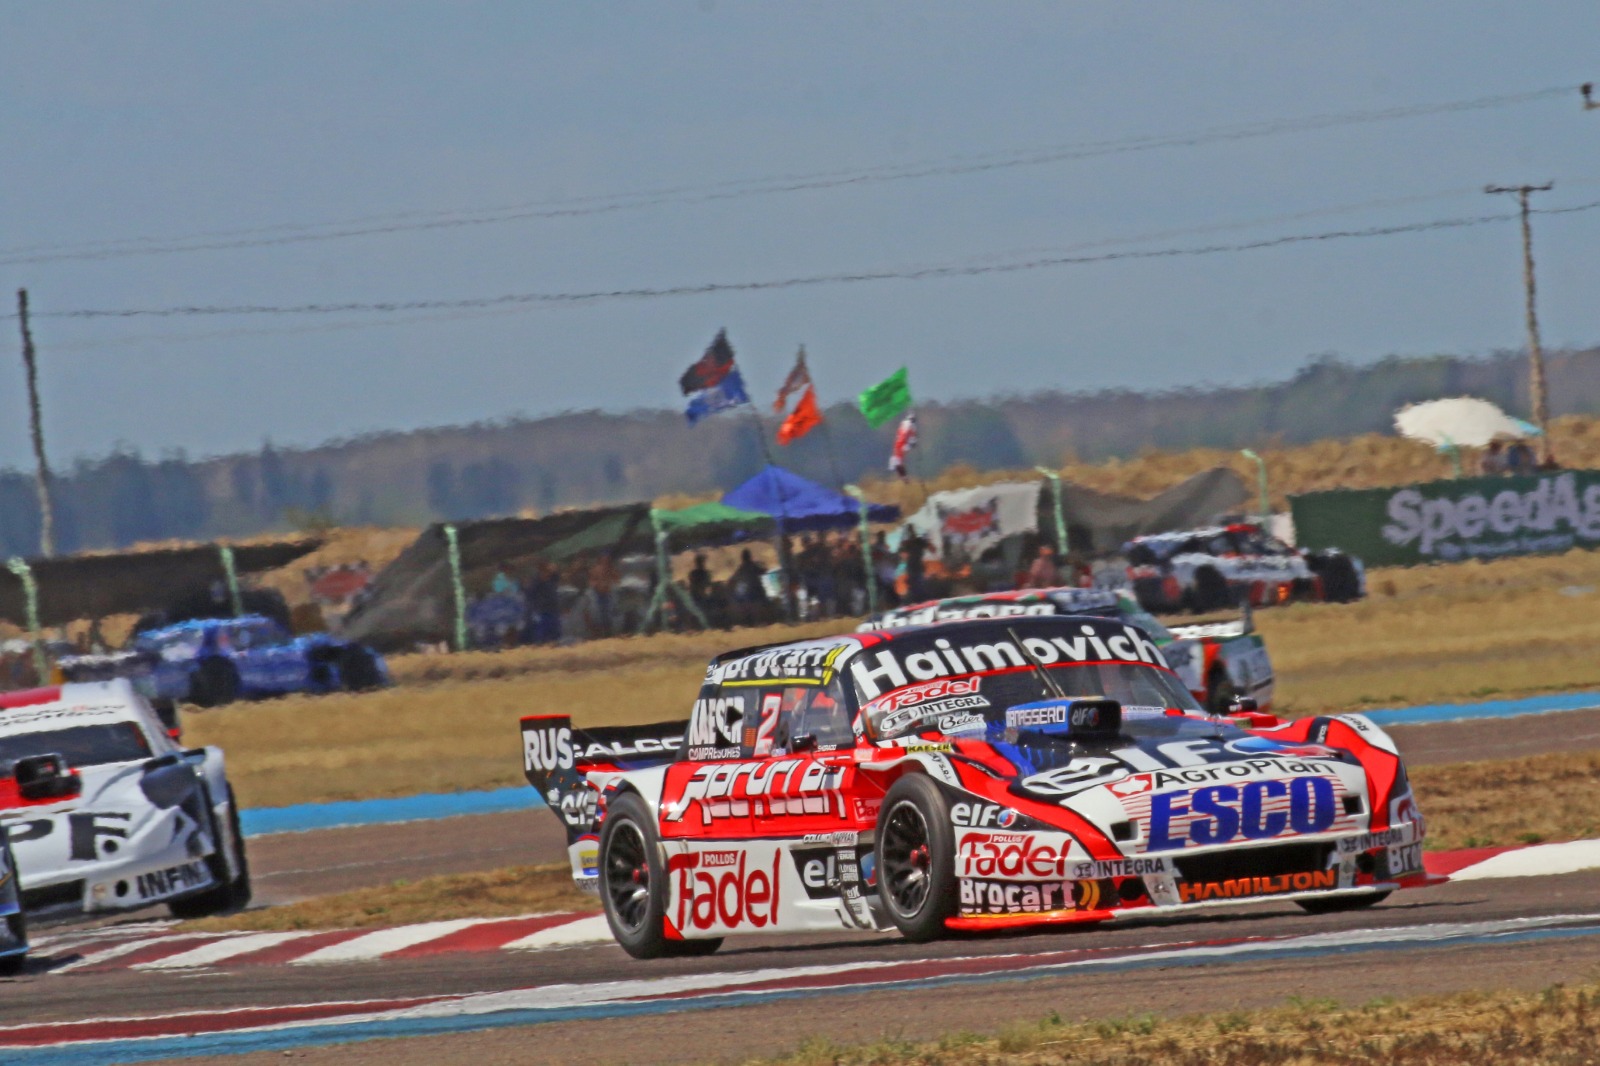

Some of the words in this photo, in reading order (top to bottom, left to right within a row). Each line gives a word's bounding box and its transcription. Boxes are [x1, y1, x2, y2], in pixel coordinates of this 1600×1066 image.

[850, 625, 1168, 700] Haimovich
[878, 676, 982, 712] Fadel
[918, 696, 985, 715] INTEGRA
[754, 694, 782, 757] 2
[1072, 707, 1089, 726] elf
[522, 728, 573, 771] RUS
[688, 747, 741, 760] COMPRESORES
[909, 744, 949, 753] KAESER
[1022, 741, 1221, 795] elf
[1155, 758, 1336, 789] AgroPlan
[951, 802, 1001, 827] elf
[1146, 776, 1336, 852] ESCO
[704, 853, 736, 865] POLLOS
[959, 832, 1073, 877] Fadel
[1097, 858, 1165, 877] INTEGRA
[668, 847, 781, 930] Fadel
[960, 878, 1076, 917] Brocart
[1179, 869, 1335, 902] HAMILTON
